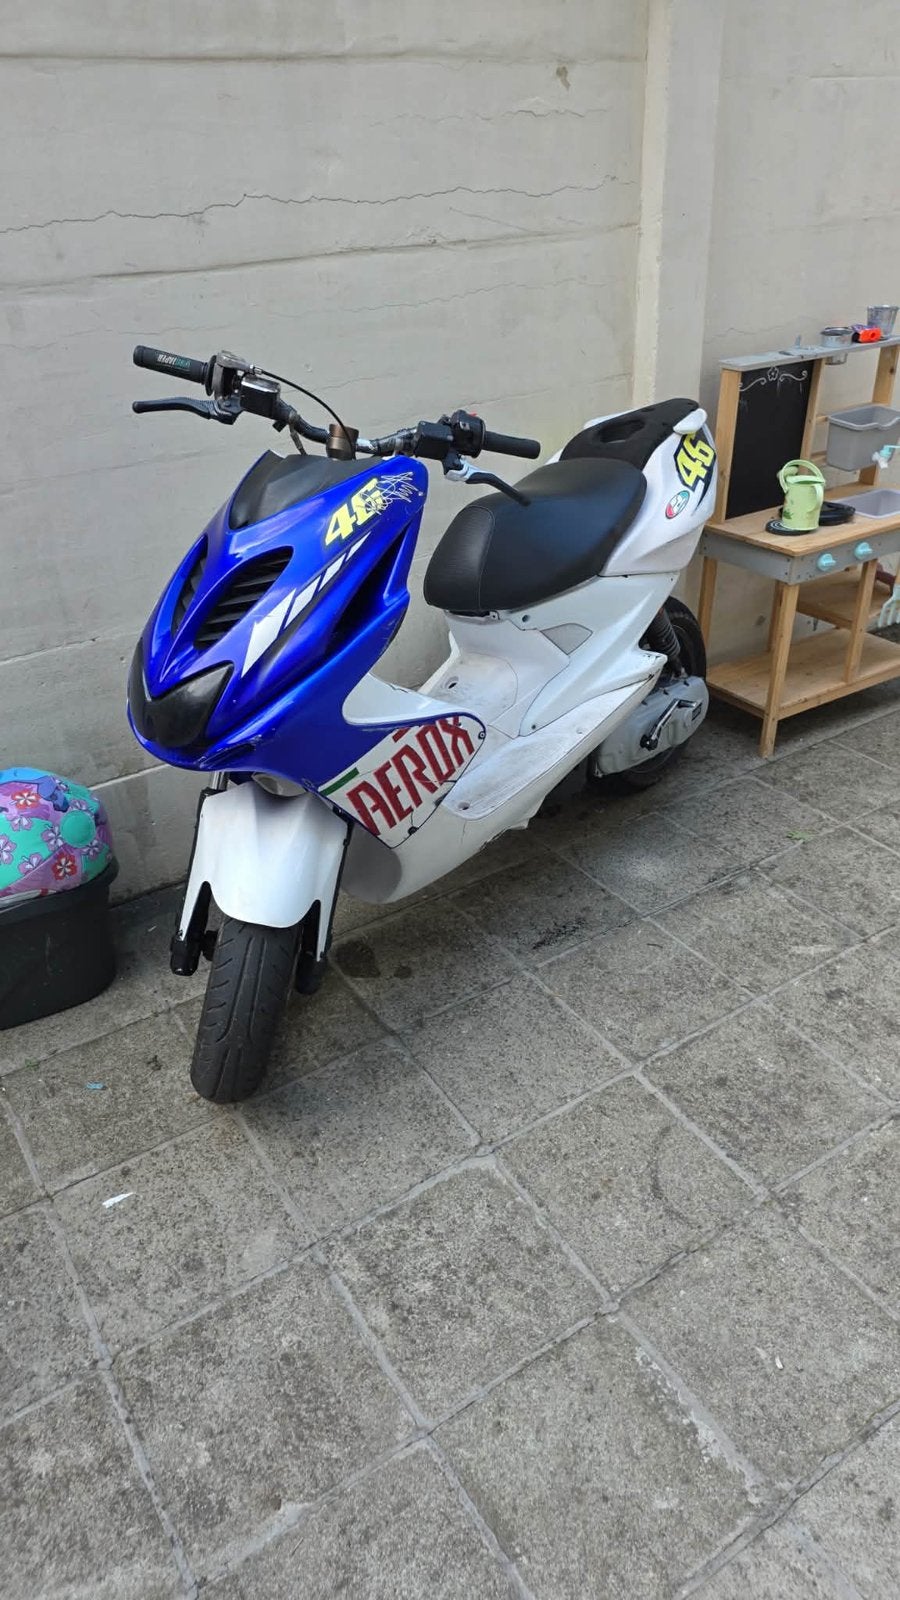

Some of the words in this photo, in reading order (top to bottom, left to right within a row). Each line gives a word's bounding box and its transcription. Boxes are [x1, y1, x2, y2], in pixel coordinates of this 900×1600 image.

[677, 433, 715, 487] 46
[325, 478, 384, 546] 46
[346, 716, 475, 837] AEROX
